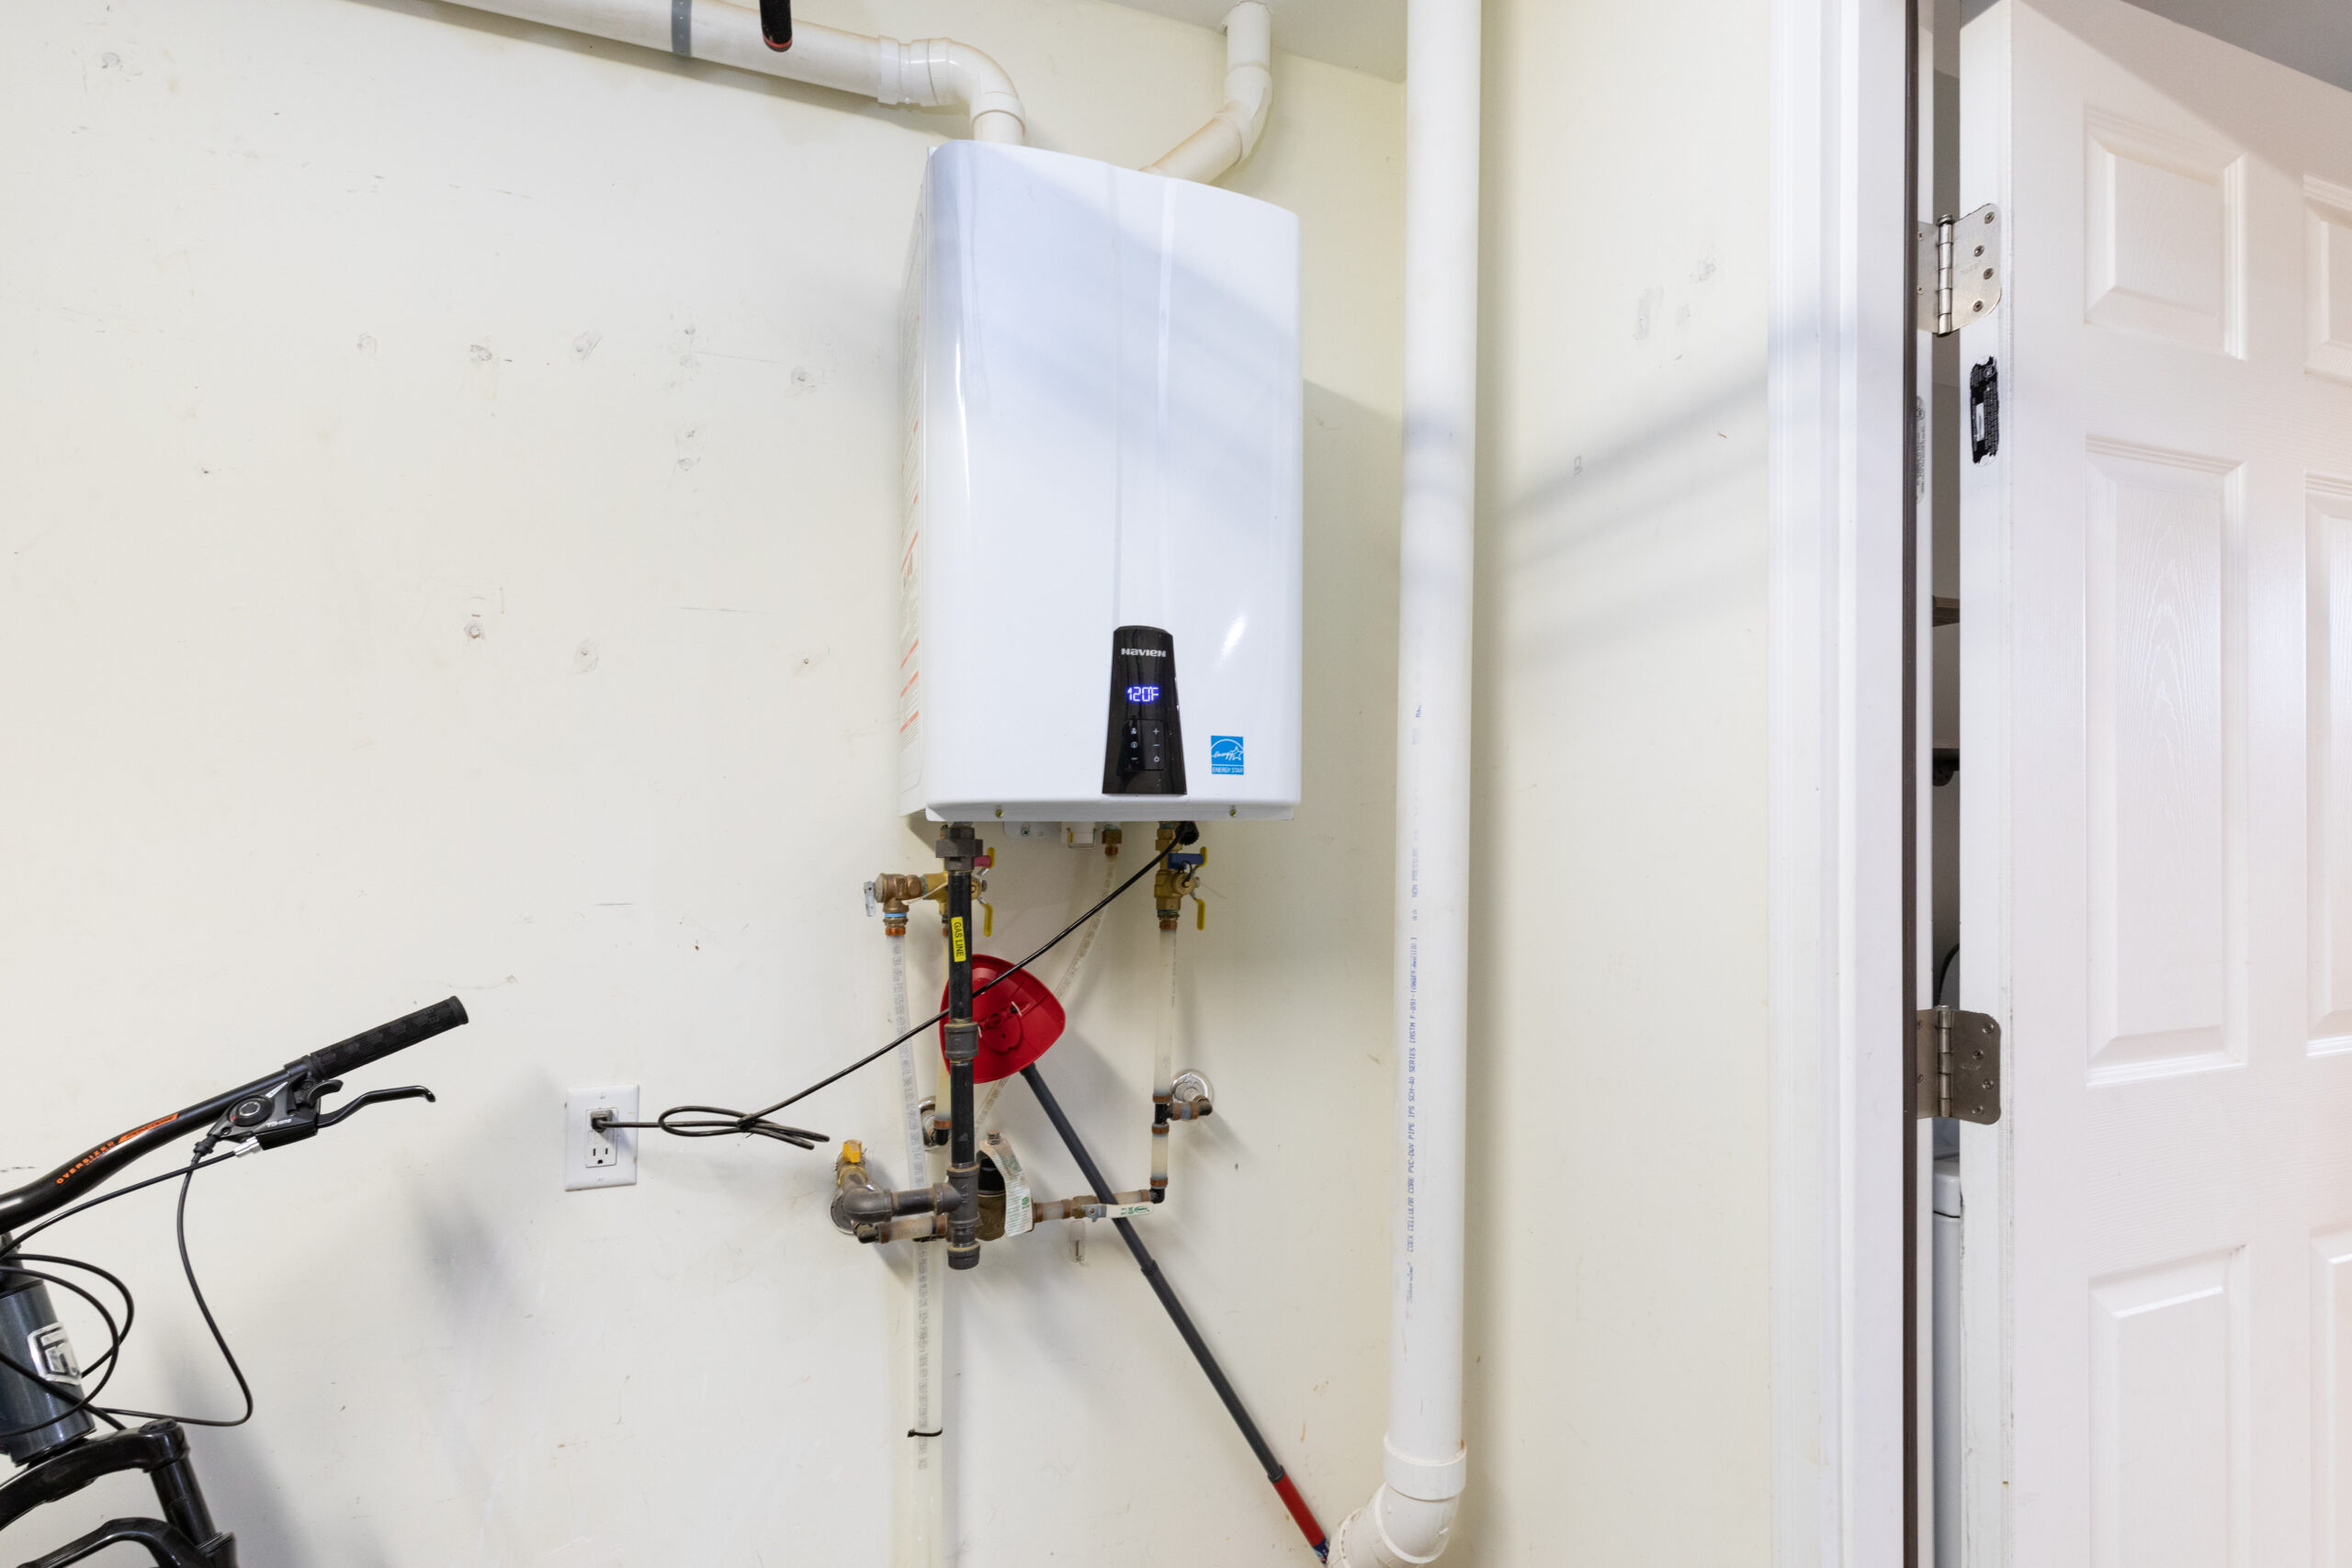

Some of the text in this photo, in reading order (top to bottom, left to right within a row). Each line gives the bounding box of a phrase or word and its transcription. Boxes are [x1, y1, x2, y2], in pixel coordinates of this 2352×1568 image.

[954, 921, 965, 957] GAS LINE
[55, 1140, 116, 1185] OVERSIZED
[1407, 1177, 1415, 1194] CORE
